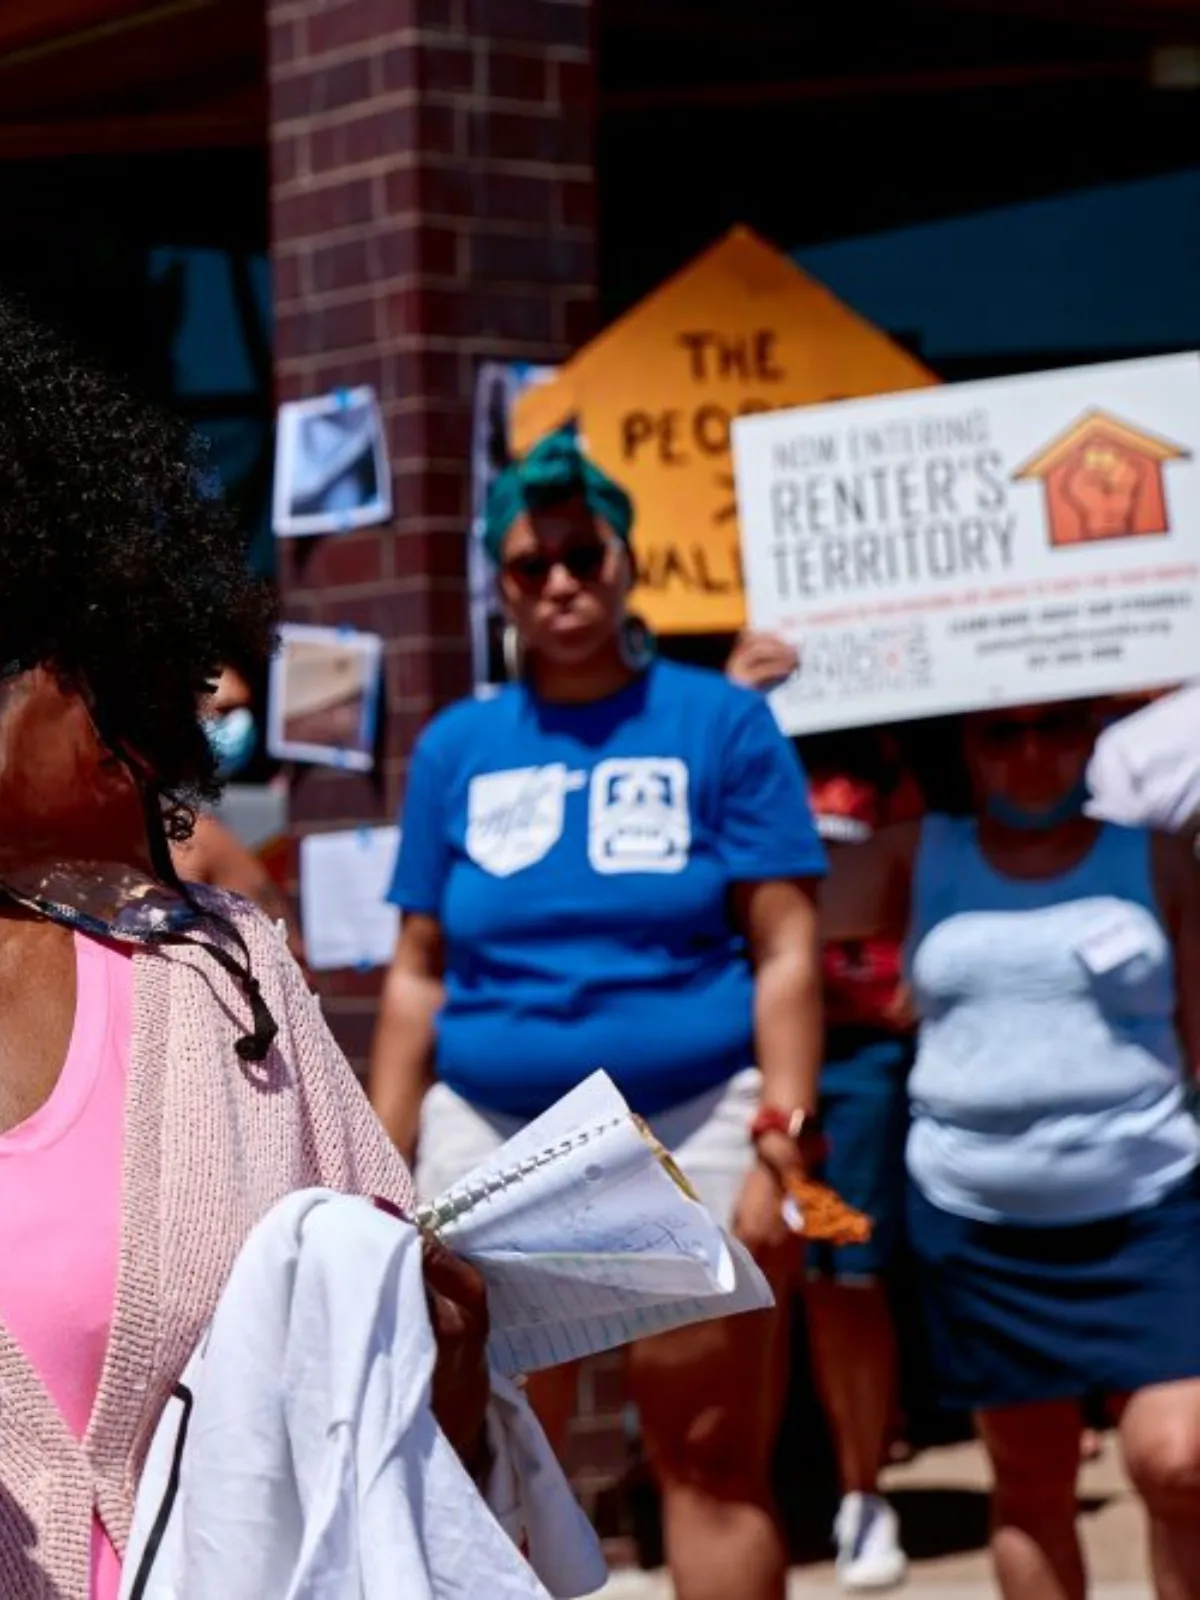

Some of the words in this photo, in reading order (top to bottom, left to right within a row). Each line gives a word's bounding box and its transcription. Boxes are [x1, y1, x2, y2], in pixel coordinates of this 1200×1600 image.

[679, 326, 785, 384] THE
[620, 398, 776, 464] PEO
[772, 434, 836, 472] NOW
[847, 408, 990, 454] ENTERING
[768, 450, 1008, 540] RENTER'S
[770, 517, 1018, 602] TERRITORY
